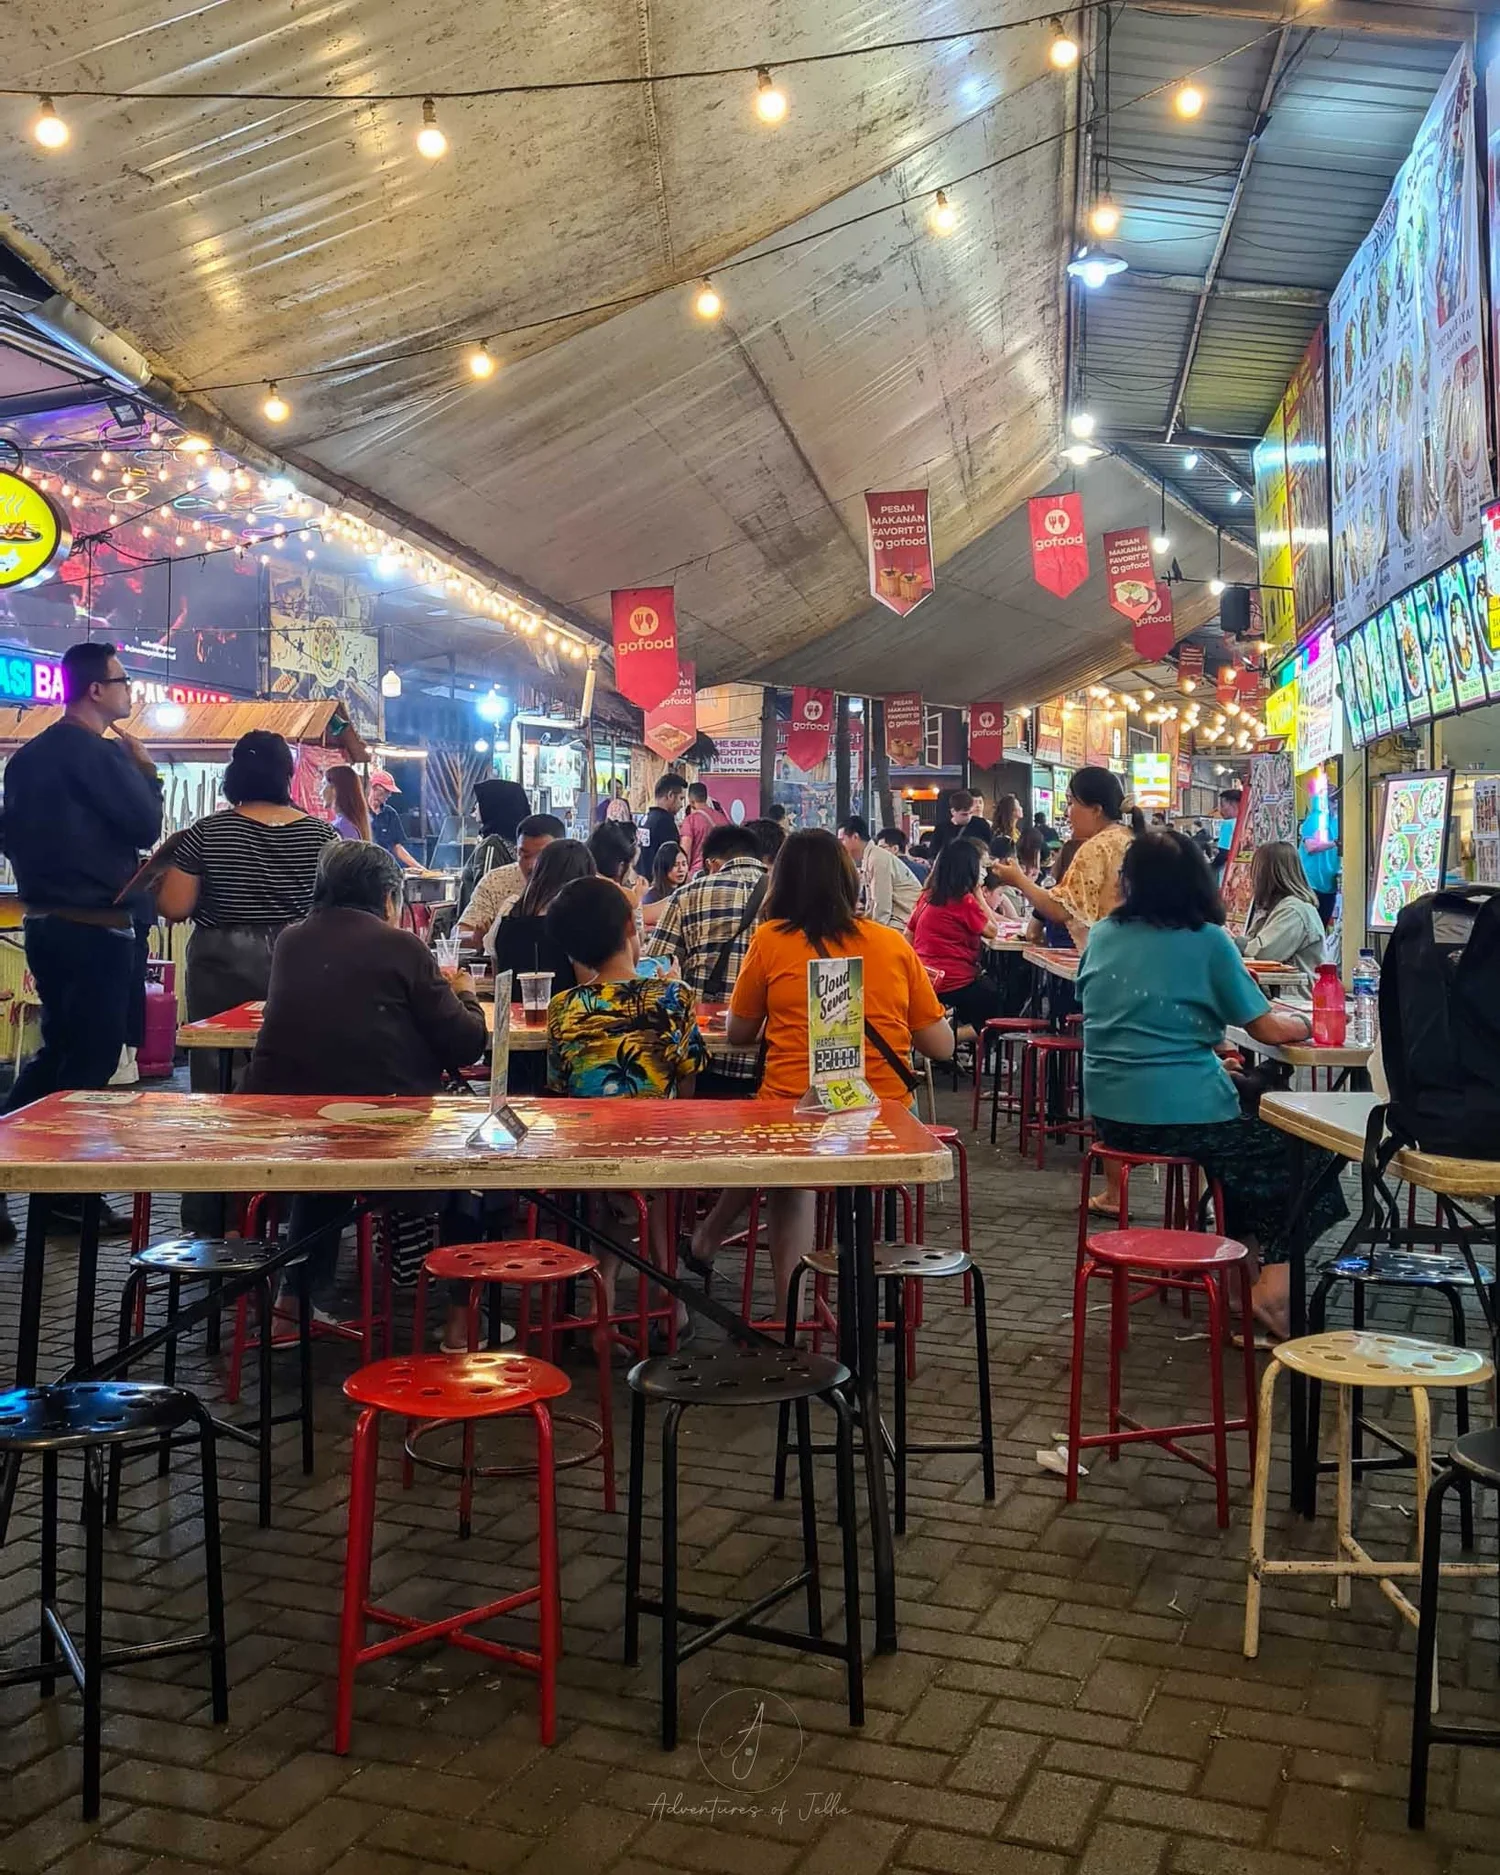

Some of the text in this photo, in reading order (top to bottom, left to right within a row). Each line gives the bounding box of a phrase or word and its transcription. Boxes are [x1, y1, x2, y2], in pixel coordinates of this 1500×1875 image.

[881, 504, 915, 513] PESAN
[871, 514, 925, 525] MAKANAN
[872, 525, 926, 536] FAVORIT DI
[885, 536, 927, 550] gofood
[1035, 532, 1084, 551] gofood
[1115, 537, 1140, 547] PESAN
[1108, 545, 1148, 557] MAKANAN
[1109, 551, 1150, 564] FAVORIT DI
[1120, 560, 1150, 572] gofood
[1134, 613, 1172, 627] gofood
[618, 636, 675, 656] gofood
[793, 721, 830, 732] gofood
[895, 719, 920, 727] gofood
[972, 728, 1002, 738] gofood
[815, 964, 851, 999] Cloud
[819, 987, 853, 1020] Seven
